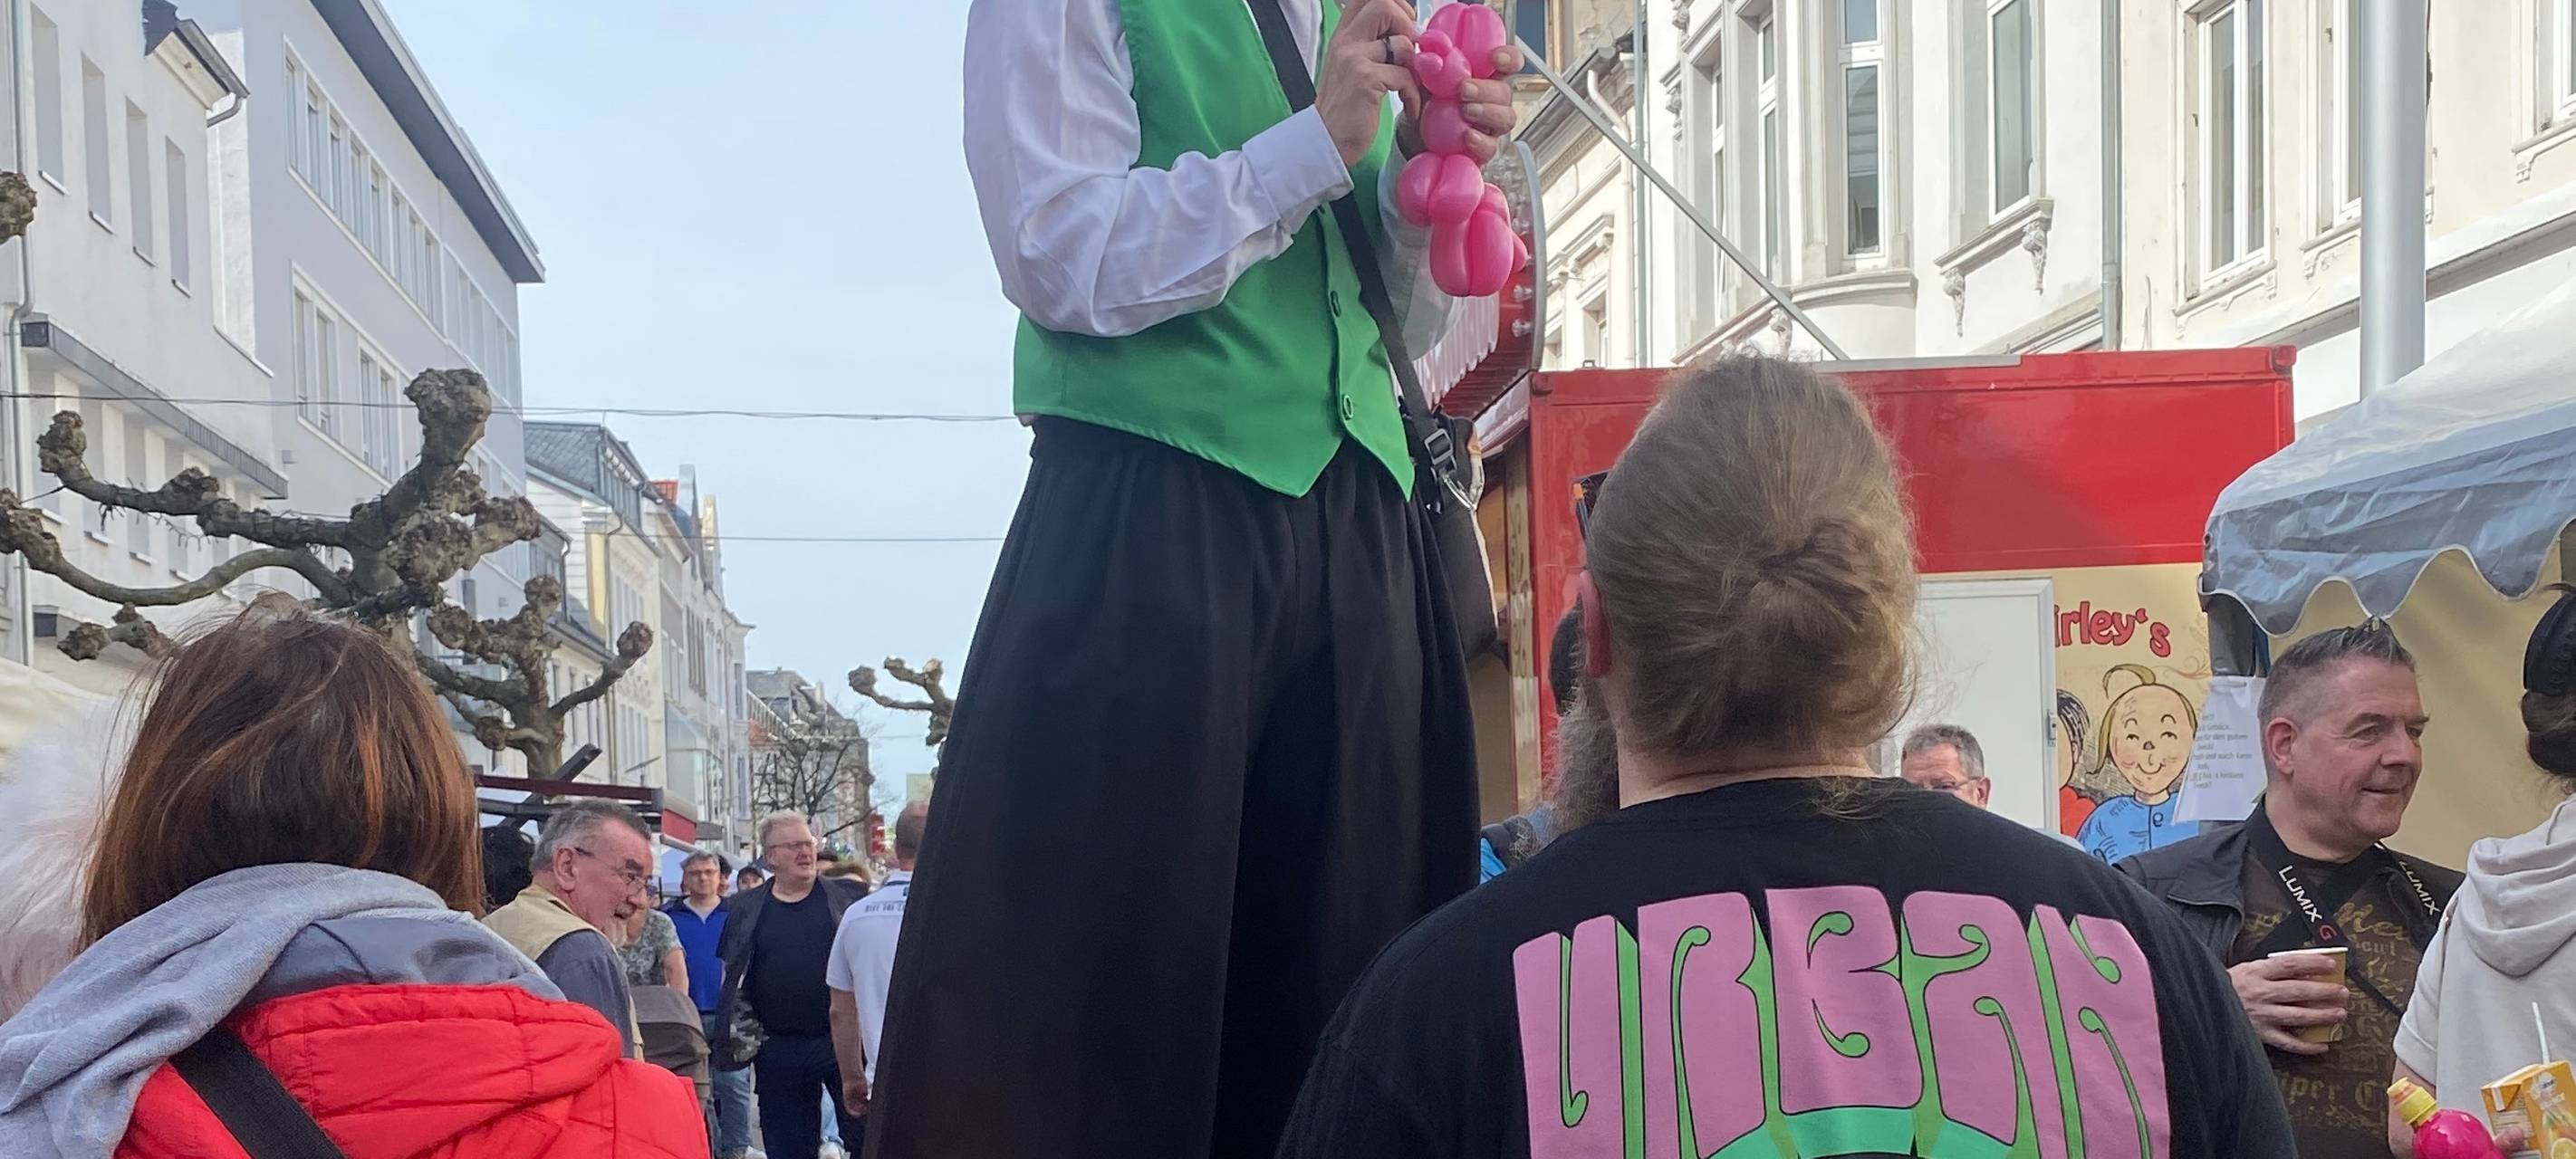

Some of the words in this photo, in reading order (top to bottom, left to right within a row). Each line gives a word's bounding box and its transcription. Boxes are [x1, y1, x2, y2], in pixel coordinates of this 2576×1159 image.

[2053, 601, 2171, 658] irley's
[2278, 864, 2323, 924] LUMIX
[2319, 924, 2339, 942] G
[2398, 860, 2442, 916] LUMIX
[1513, 885, 2172, 1159] URBAN
